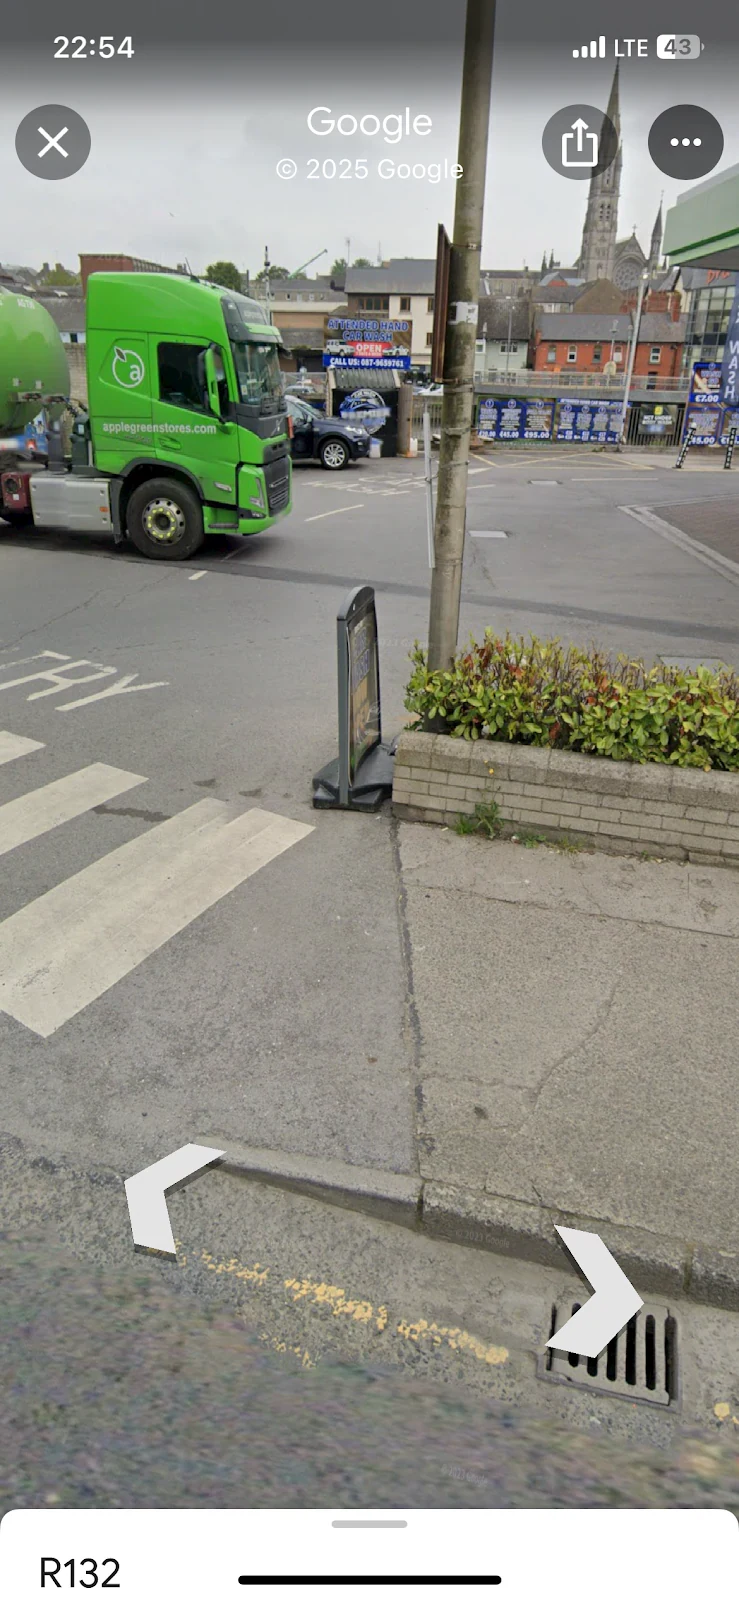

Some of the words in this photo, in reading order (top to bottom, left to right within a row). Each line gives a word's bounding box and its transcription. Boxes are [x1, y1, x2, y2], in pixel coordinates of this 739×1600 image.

[328, 319, 379, 331] ATTENDED
[380, 321, 409, 331] HAND
[342, 331, 363, 341] CAR
[364, 332, 393, 342] WASH
[356, 343, 383, 353] OPEN
[330, 357, 347, 366] CALL
[348, 358, 360, 367] US:
[695, 394, 719, 402] €7.00
[103, 422, 217, 435] applegreenstores.com
[524, 431, 550, 439] €95.00
